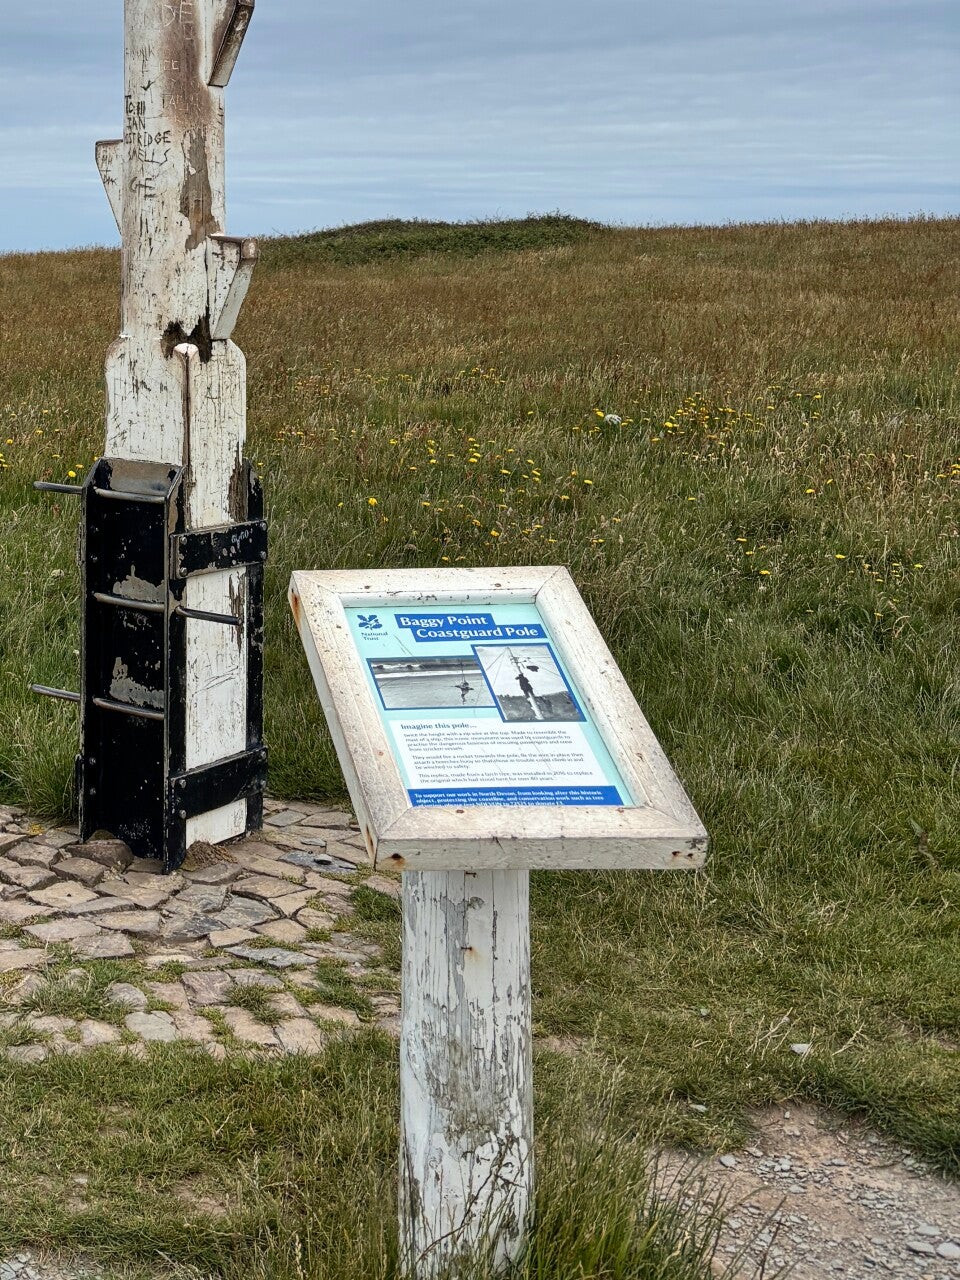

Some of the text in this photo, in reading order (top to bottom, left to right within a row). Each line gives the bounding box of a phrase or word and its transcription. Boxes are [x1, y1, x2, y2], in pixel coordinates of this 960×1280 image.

[400, 616, 488, 627] Baggy Point
[416, 626, 538, 639] Coastguard Pole
